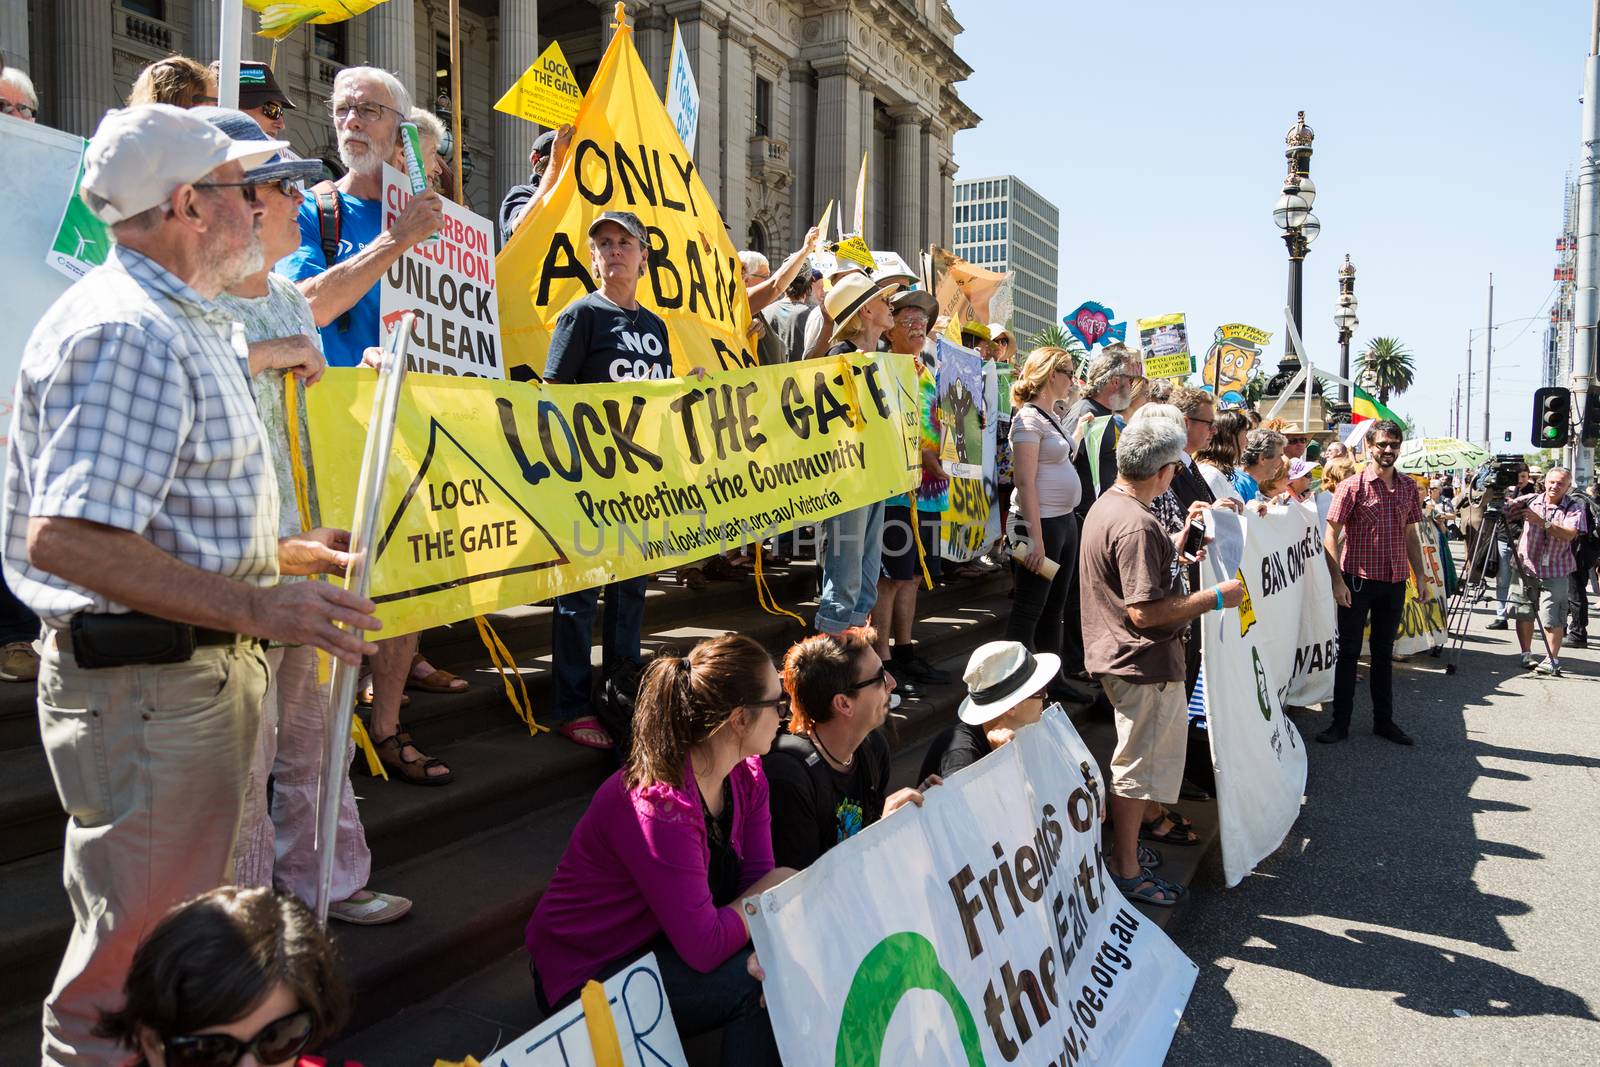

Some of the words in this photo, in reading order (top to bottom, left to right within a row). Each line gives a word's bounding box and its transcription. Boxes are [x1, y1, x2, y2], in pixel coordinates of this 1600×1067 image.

[533, 69, 552, 88] THE
[554, 78, 578, 98] GATE
[543, 57, 568, 79] LOCK
[574, 139, 699, 217] ONLY
[387, 183, 413, 215] CU
[438, 214, 488, 256] RBON
[387, 253, 494, 325] UNLOCK
[536, 232, 600, 307] A
[645, 225, 737, 328] BAN
[410, 308, 497, 368] CLEAN
[618, 332, 662, 356] NO
[1077, 315, 1107, 337] WATER
[495, 395, 663, 486] LOCK
[669, 381, 767, 465] THE
[428, 478, 490, 512] LOCK
[574, 481, 708, 528] Protecting
[705, 468, 748, 505] the
[748, 439, 866, 493] Community
[408, 529, 456, 563] THE
[460, 520, 518, 553] GATE
[1261, 551, 1288, 598] BAN
[1067, 760, 1101, 833] of
[983, 946, 1059, 1063] the
